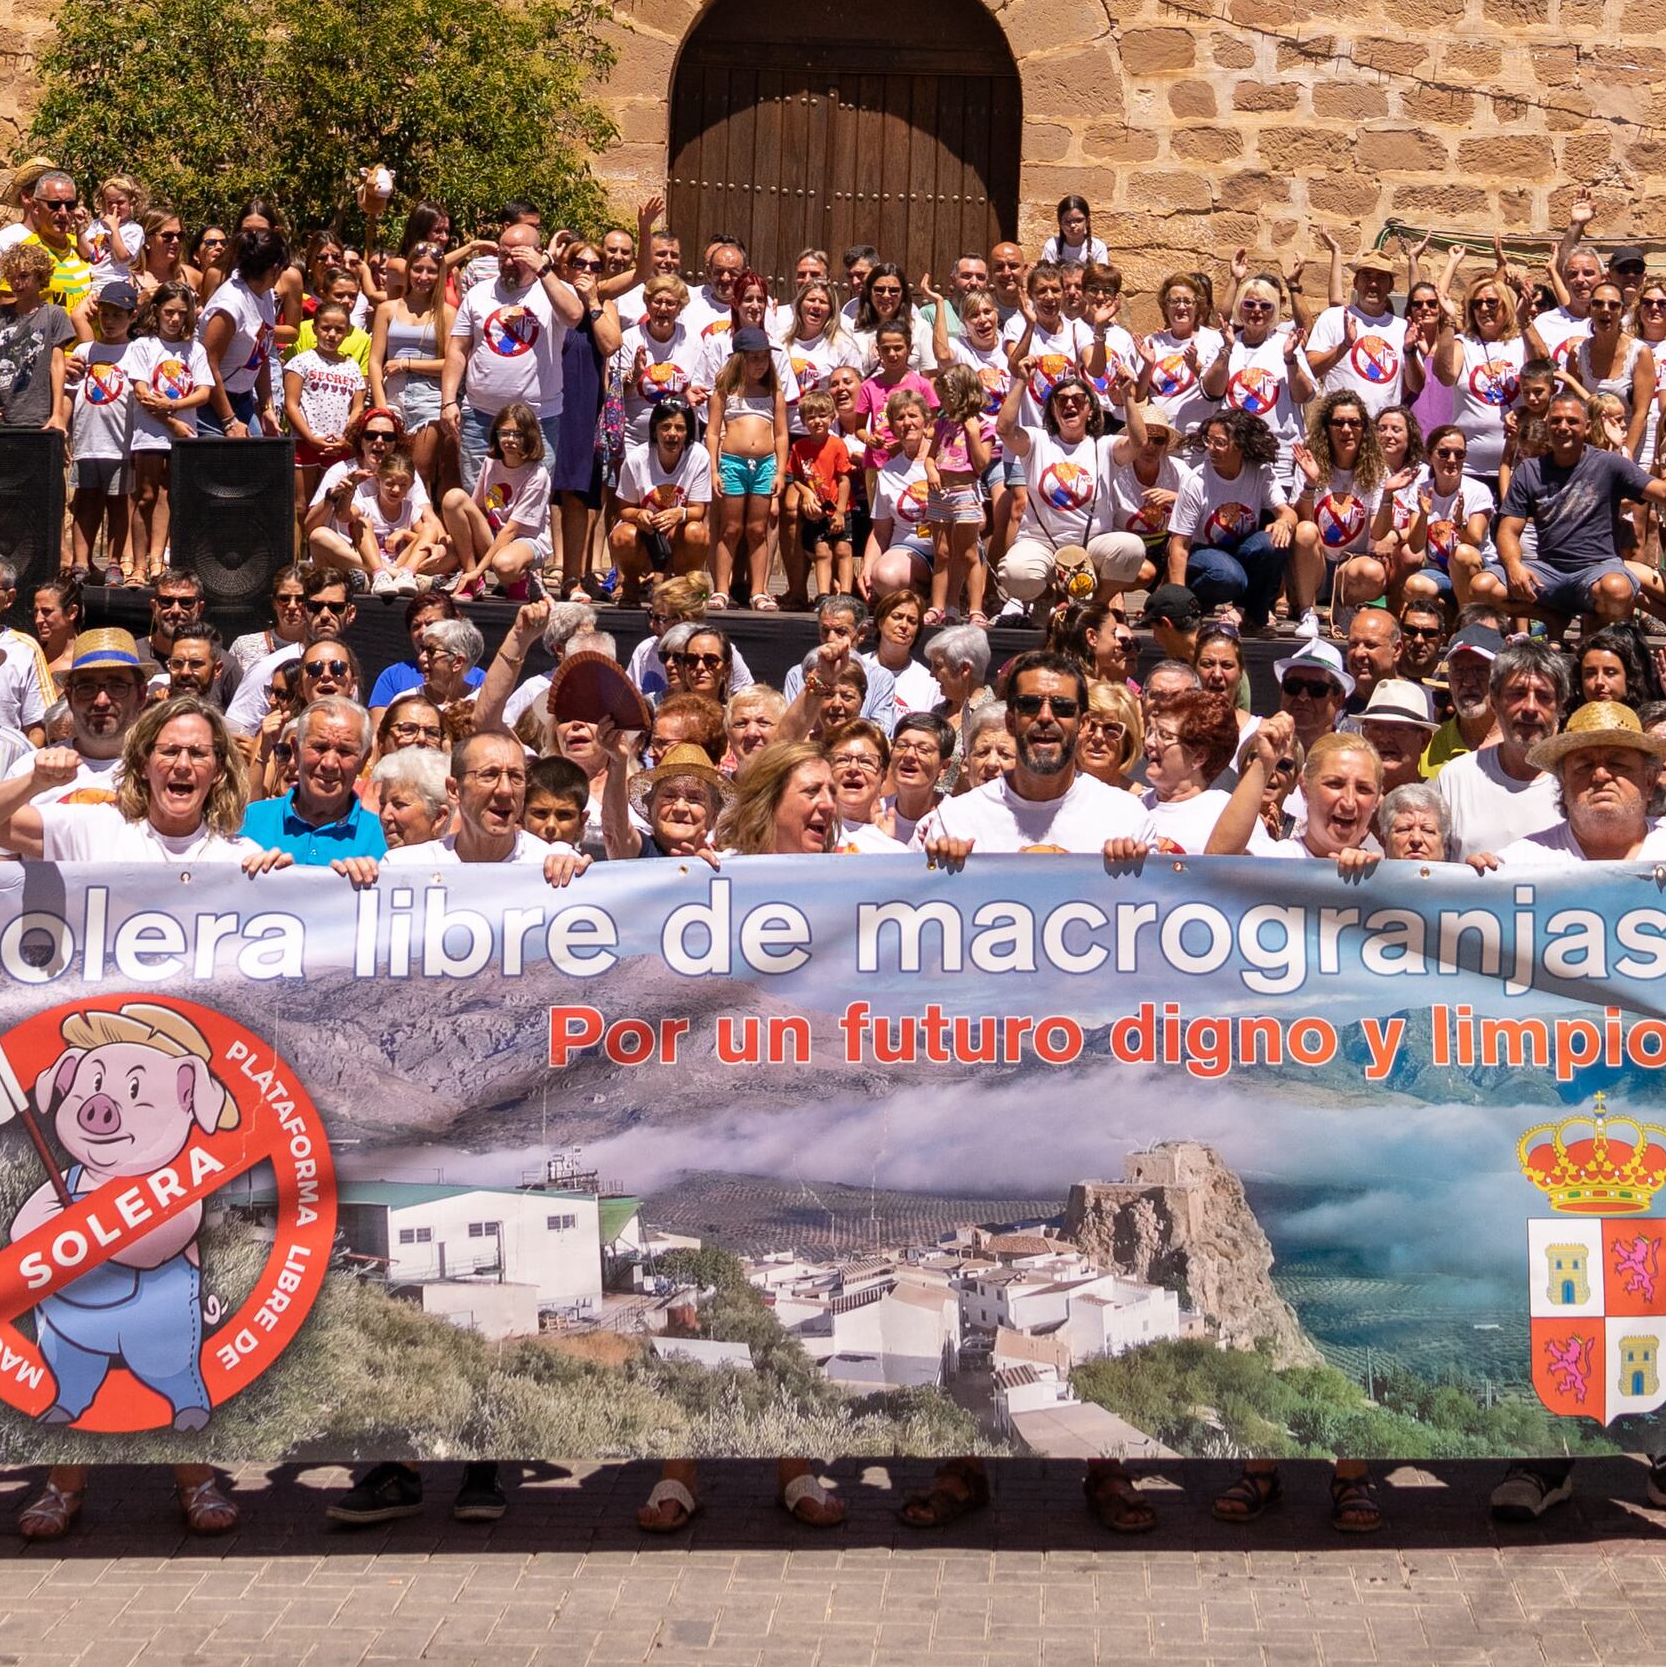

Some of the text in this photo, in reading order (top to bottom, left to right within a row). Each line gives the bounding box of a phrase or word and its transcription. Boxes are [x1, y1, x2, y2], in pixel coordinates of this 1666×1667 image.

[1386, 351, 1397, 359] NO
[309, 370, 355, 389] SECRET
[807, 371, 820, 380] NO
[1266, 378, 1279, 387] NO
[1080, 475, 1094, 483] NO
[1354, 509, 1366, 518] NO
[1398, 509, 1409, 517] NO
[896, 706, 912, 716] NO
[354, 885, 619, 980] libre
[661, 877, 813, 977] de
[548, 1004, 689, 1069] Por
[715, 1014, 813, 1065] un
[839, 1001, 1085, 1066] futuro
[1110, 1001, 1337, 1079] digno
[1361, 1014, 1407, 1081] y
[224, 1039, 321, 1228] PLATAFORMA
[18, 1145, 226, 1291] SOLERA
[253, 1243, 312, 1333] LIBRE
[215, 1330, 260, 1372] DE
